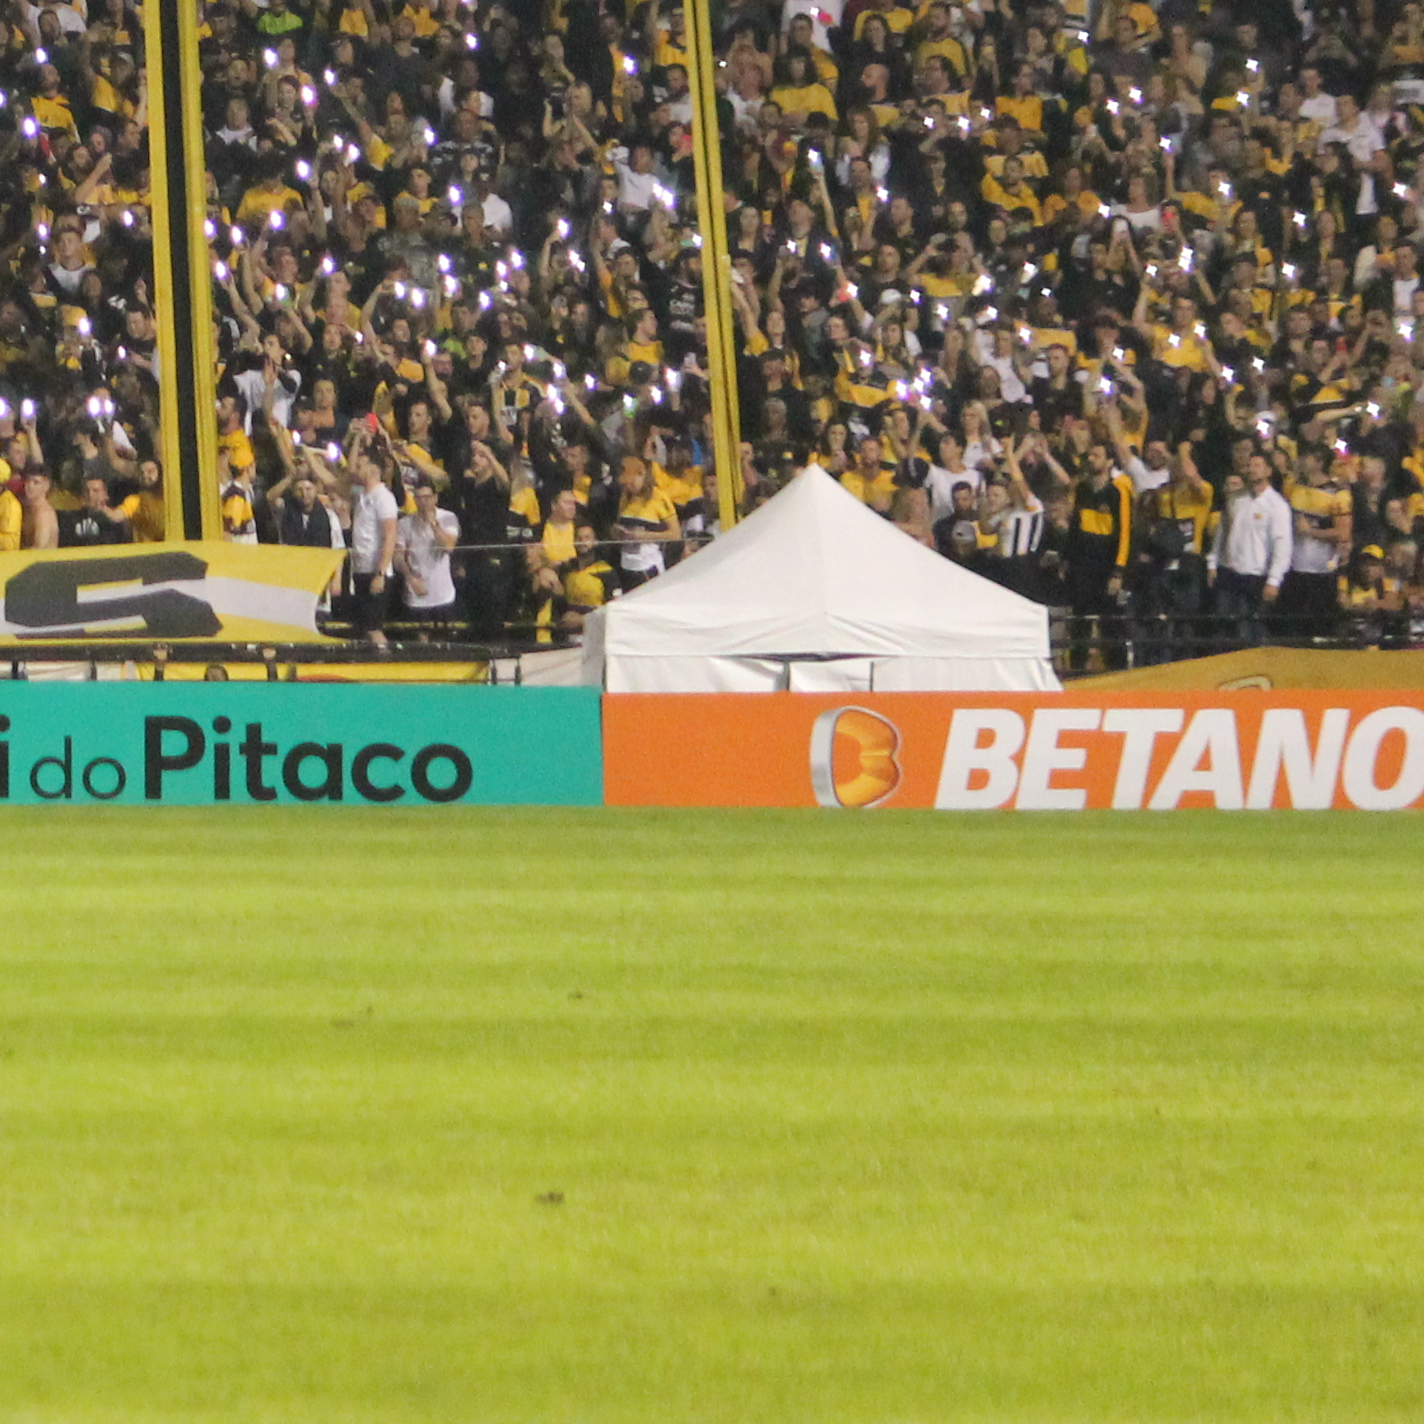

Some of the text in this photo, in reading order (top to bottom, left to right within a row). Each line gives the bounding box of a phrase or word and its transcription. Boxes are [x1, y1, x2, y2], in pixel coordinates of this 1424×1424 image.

[29, 735, 127, 800] do
[144, 715, 474, 803] Pitaco
[934, 706, 1424, 811] BETANO
